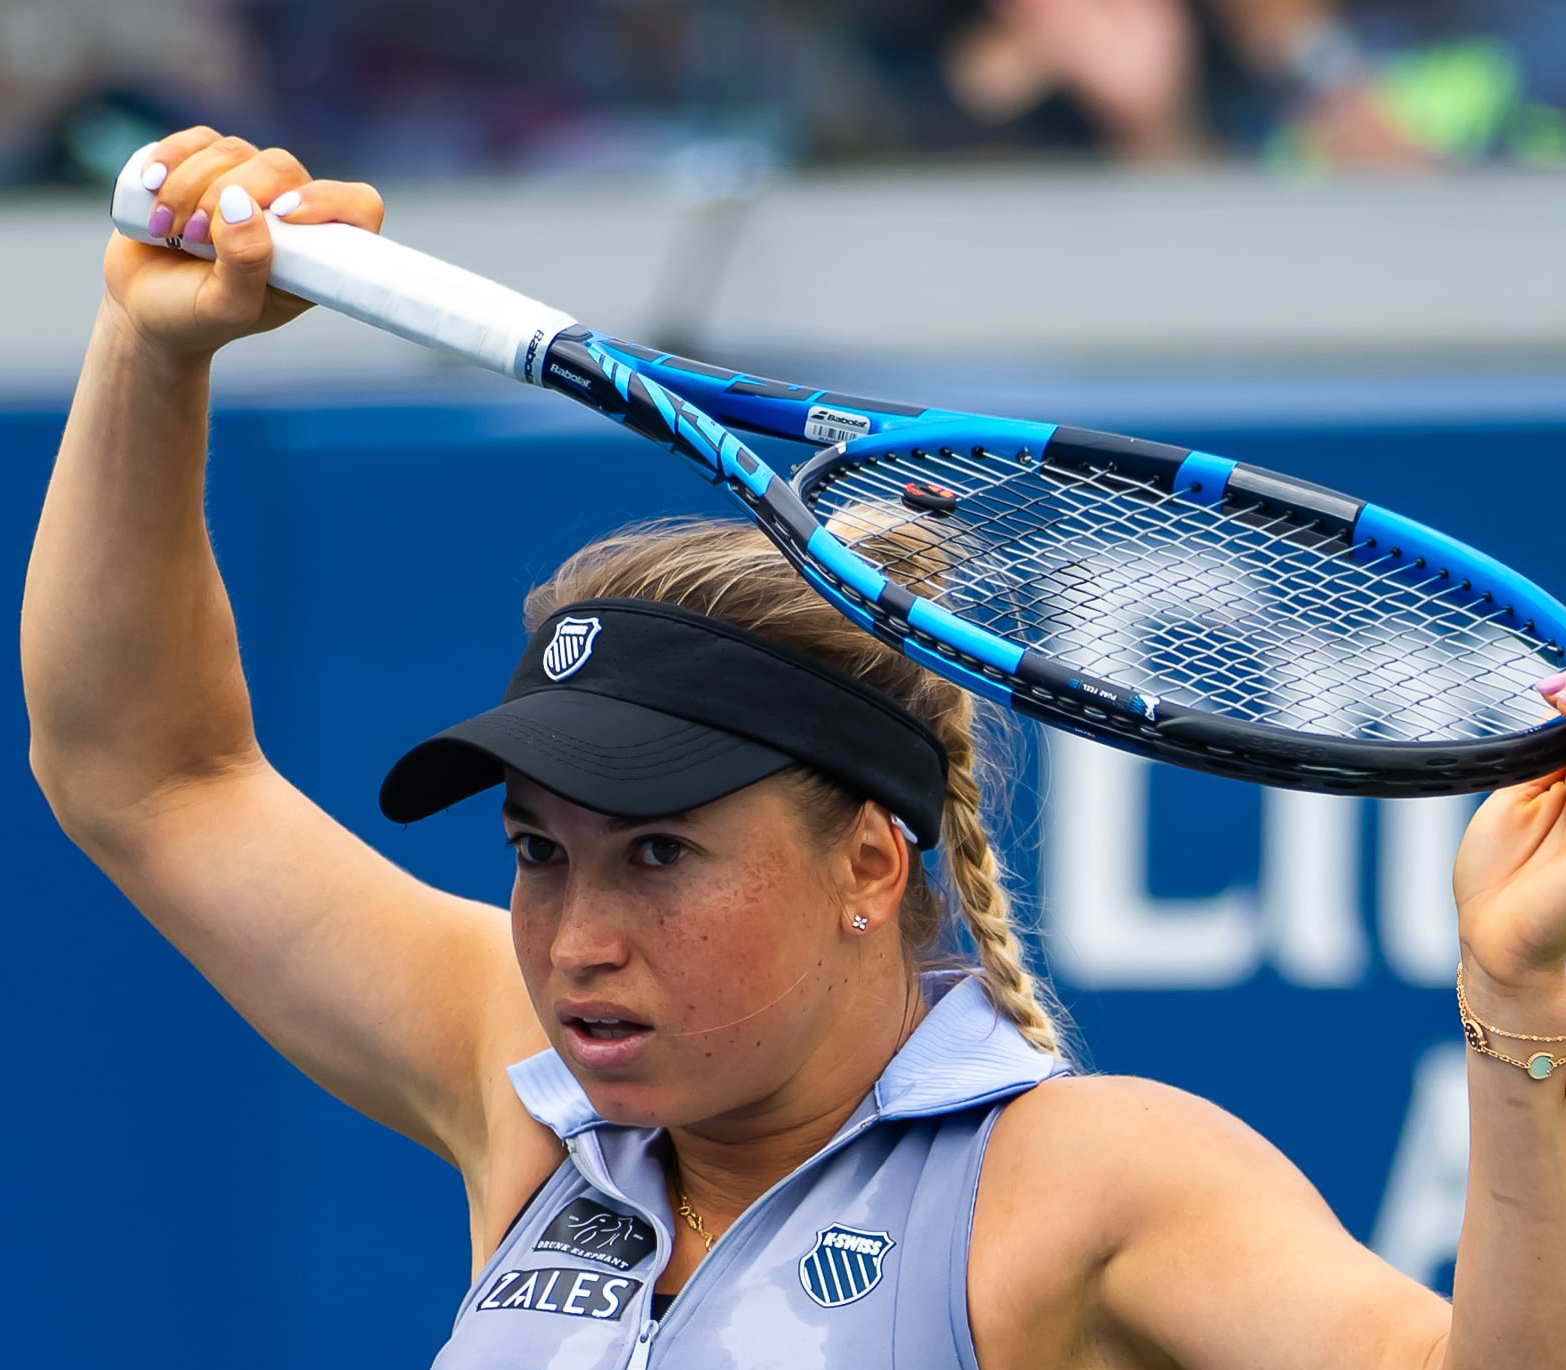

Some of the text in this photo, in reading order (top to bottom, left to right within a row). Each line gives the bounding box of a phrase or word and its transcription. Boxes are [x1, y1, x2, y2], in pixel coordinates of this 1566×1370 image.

[524, 329, 545, 384] Babol
[550, 363, 591, 388] Babolat
[827, 414, 868, 428] Babolat
[537, 1240, 629, 1269] DRUNK ELEPHANT
[822, 1232, 883, 1256] K-SWISS
[480, 1270, 629, 1318] ZALES
